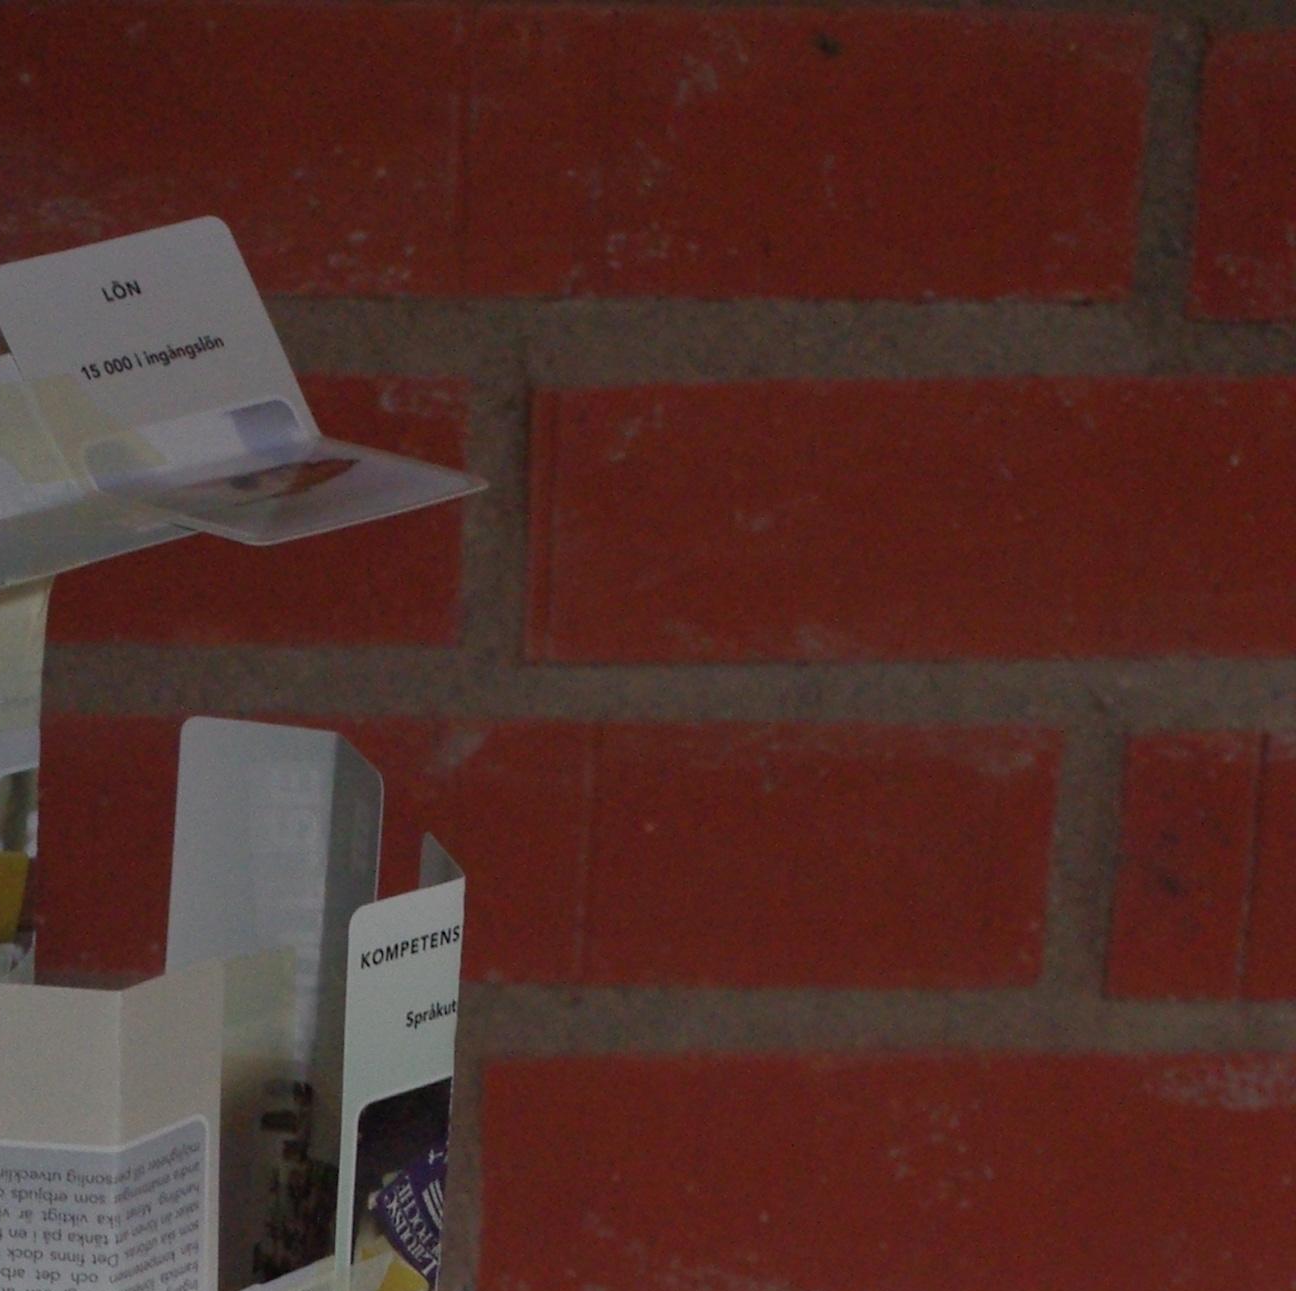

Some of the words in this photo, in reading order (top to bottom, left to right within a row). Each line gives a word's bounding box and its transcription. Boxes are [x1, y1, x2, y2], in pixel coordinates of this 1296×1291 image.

[101, 279, 141, 303] LÖN
[80, 362, 100, 381] 15
[102, 354, 133, 377] 000
[144, 332, 225, 372] ingångslön
